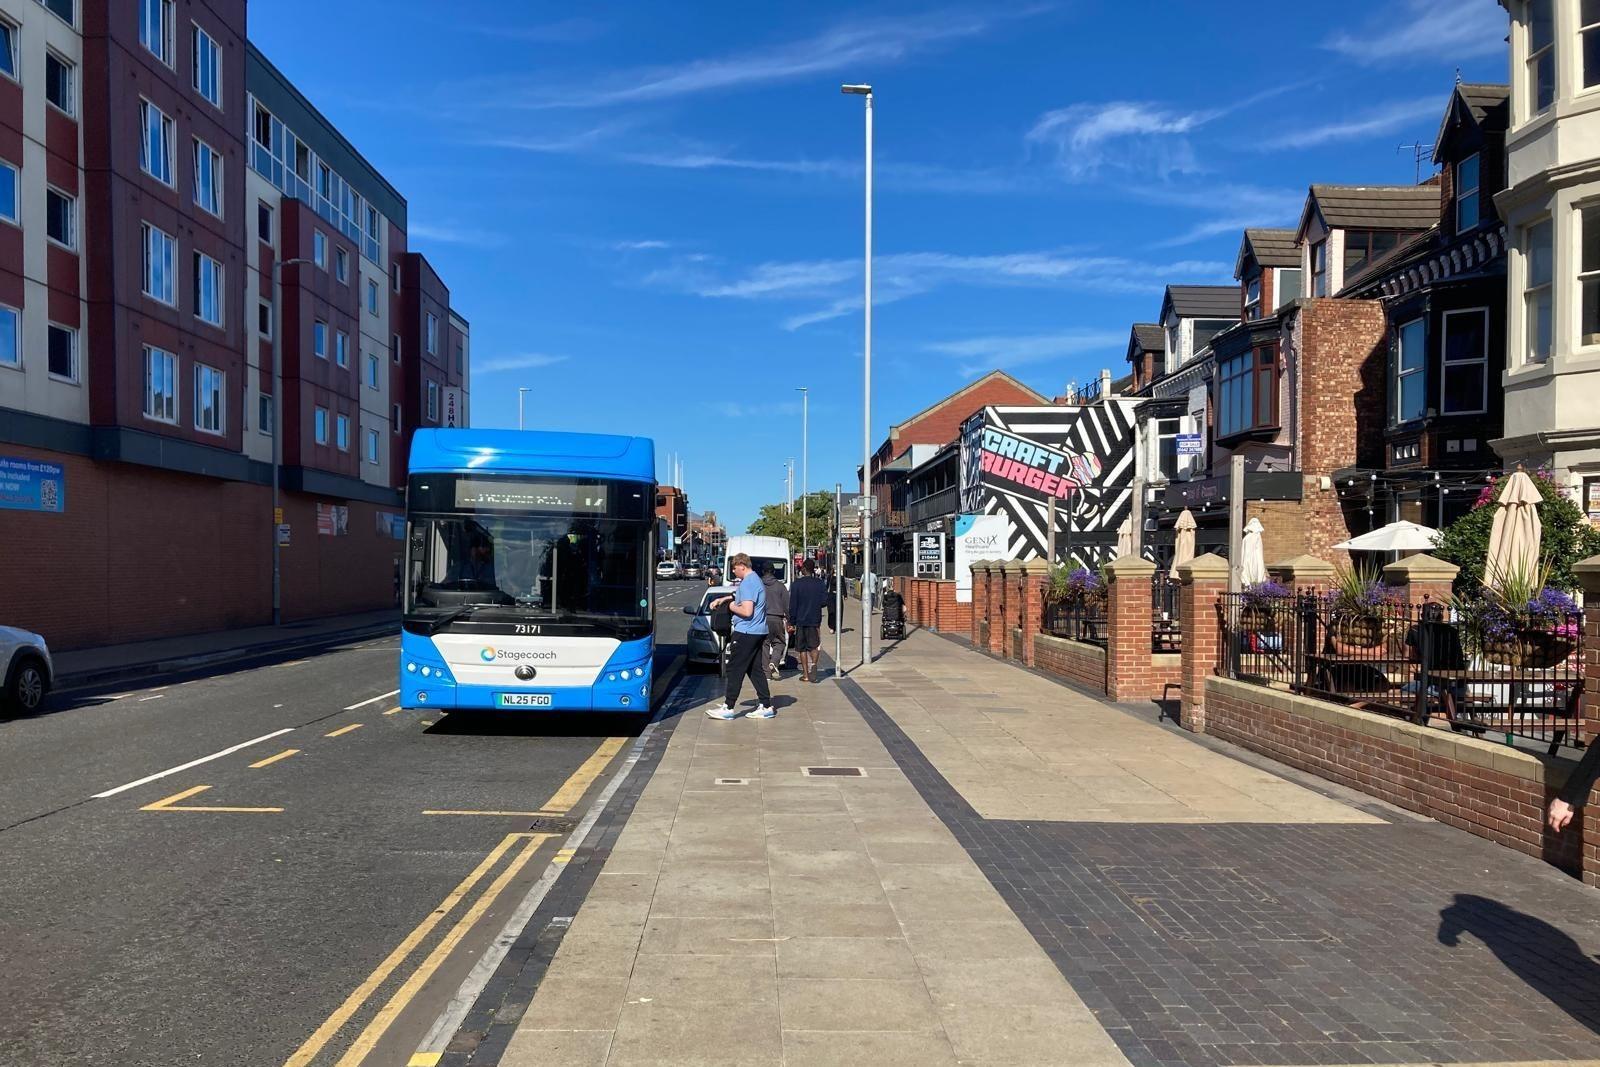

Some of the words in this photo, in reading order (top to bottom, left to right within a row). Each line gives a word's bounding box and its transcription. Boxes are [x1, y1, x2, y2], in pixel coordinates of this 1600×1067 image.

[984, 429, 1065, 474] CRAFT
[965, 534, 998, 546] GENIX
[515, 624, 541, 634] 73171
[497, 649, 557, 660] Stagecoach
[503, 695, 529, 705] NL25
[530, 695, 550, 705] FGO
